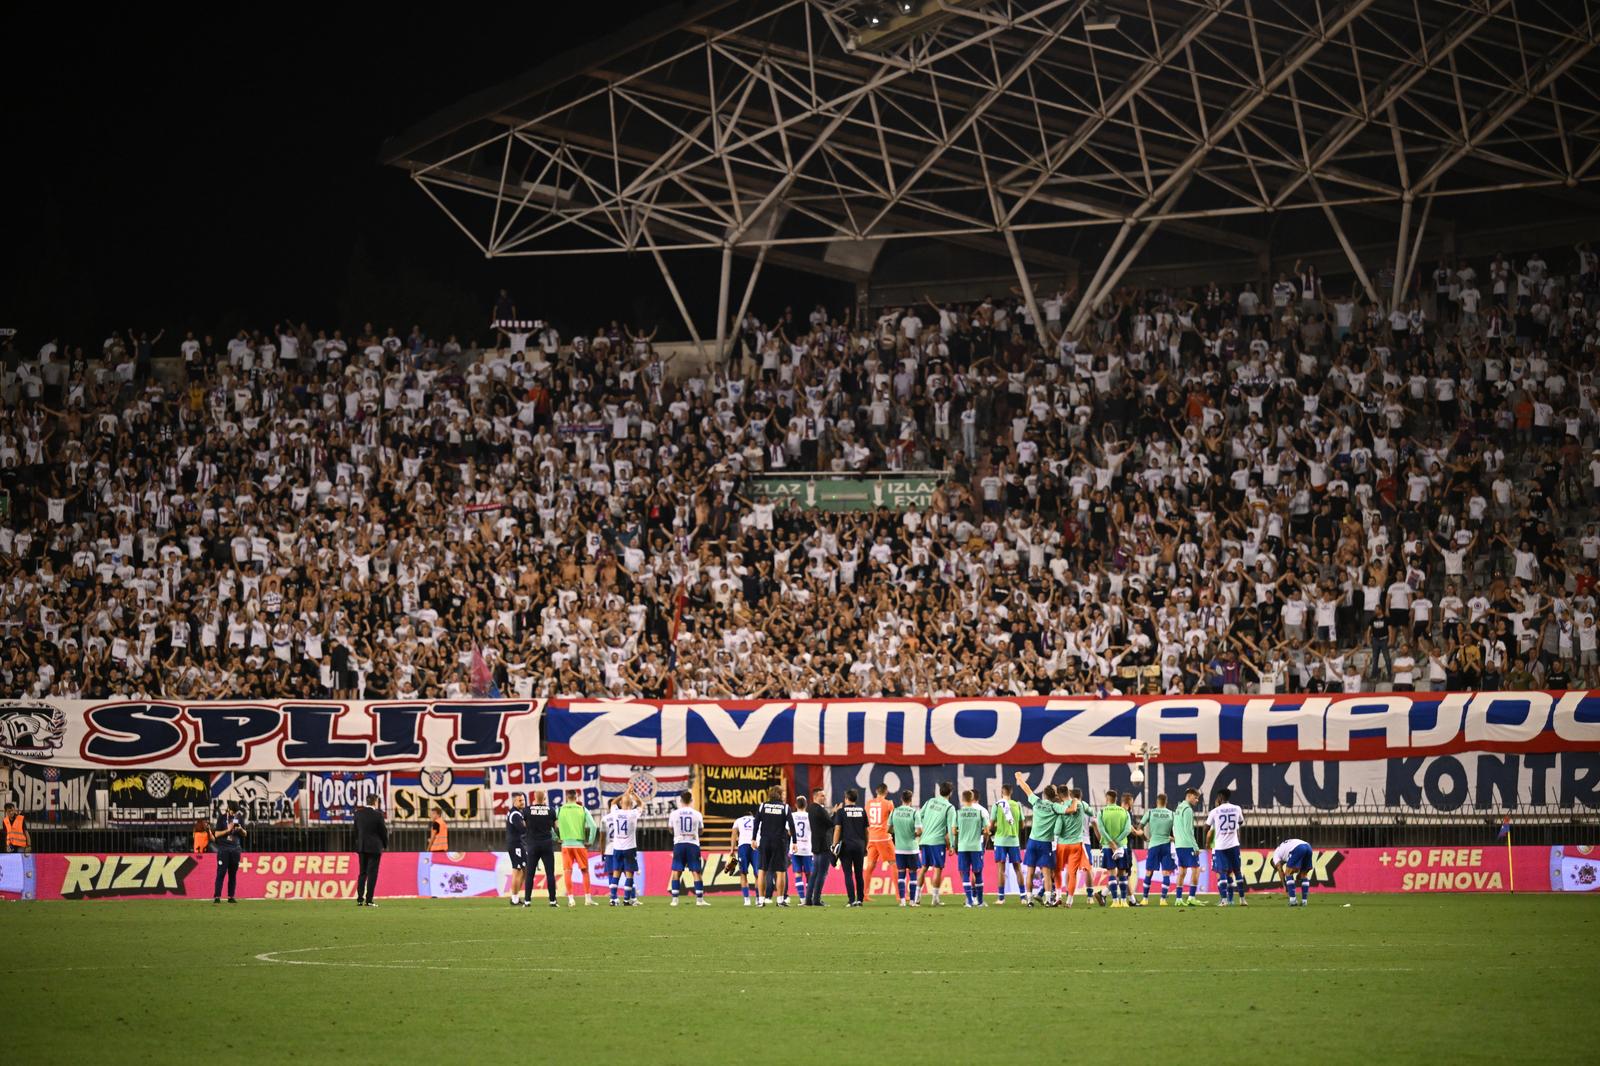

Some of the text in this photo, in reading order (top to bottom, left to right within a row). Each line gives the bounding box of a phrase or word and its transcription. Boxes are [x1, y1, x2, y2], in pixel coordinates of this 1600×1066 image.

[748, 483, 801, 494] ZLAZ
[80, 700, 538, 768] SPLIT
[1041, 699, 1220, 756] ZA
[12, 763, 94, 819] ŠIBENIK
[311, 774, 385, 811] TORCIDA
[708, 787, 772, 805] ZABRANO
[831, 763, 1090, 812] KONTRA
[395, 787, 480, 818] SINJ
[679, 816, 692, 833] 10
[869, 807, 882, 824] 91
[1218, 814, 1236, 831] 25
[616, 820, 628, 836] 14
[796, 821, 805, 838] 3
[292, 856, 350, 875] FREE
[1427, 849, 1483, 867] FREE
[60, 856, 194, 897] RIZK
[1236, 850, 1340, 886] RIK
[264, 880, 358, 899] SPINOV
[1402, 872, 1503, 890] SPINOVA
